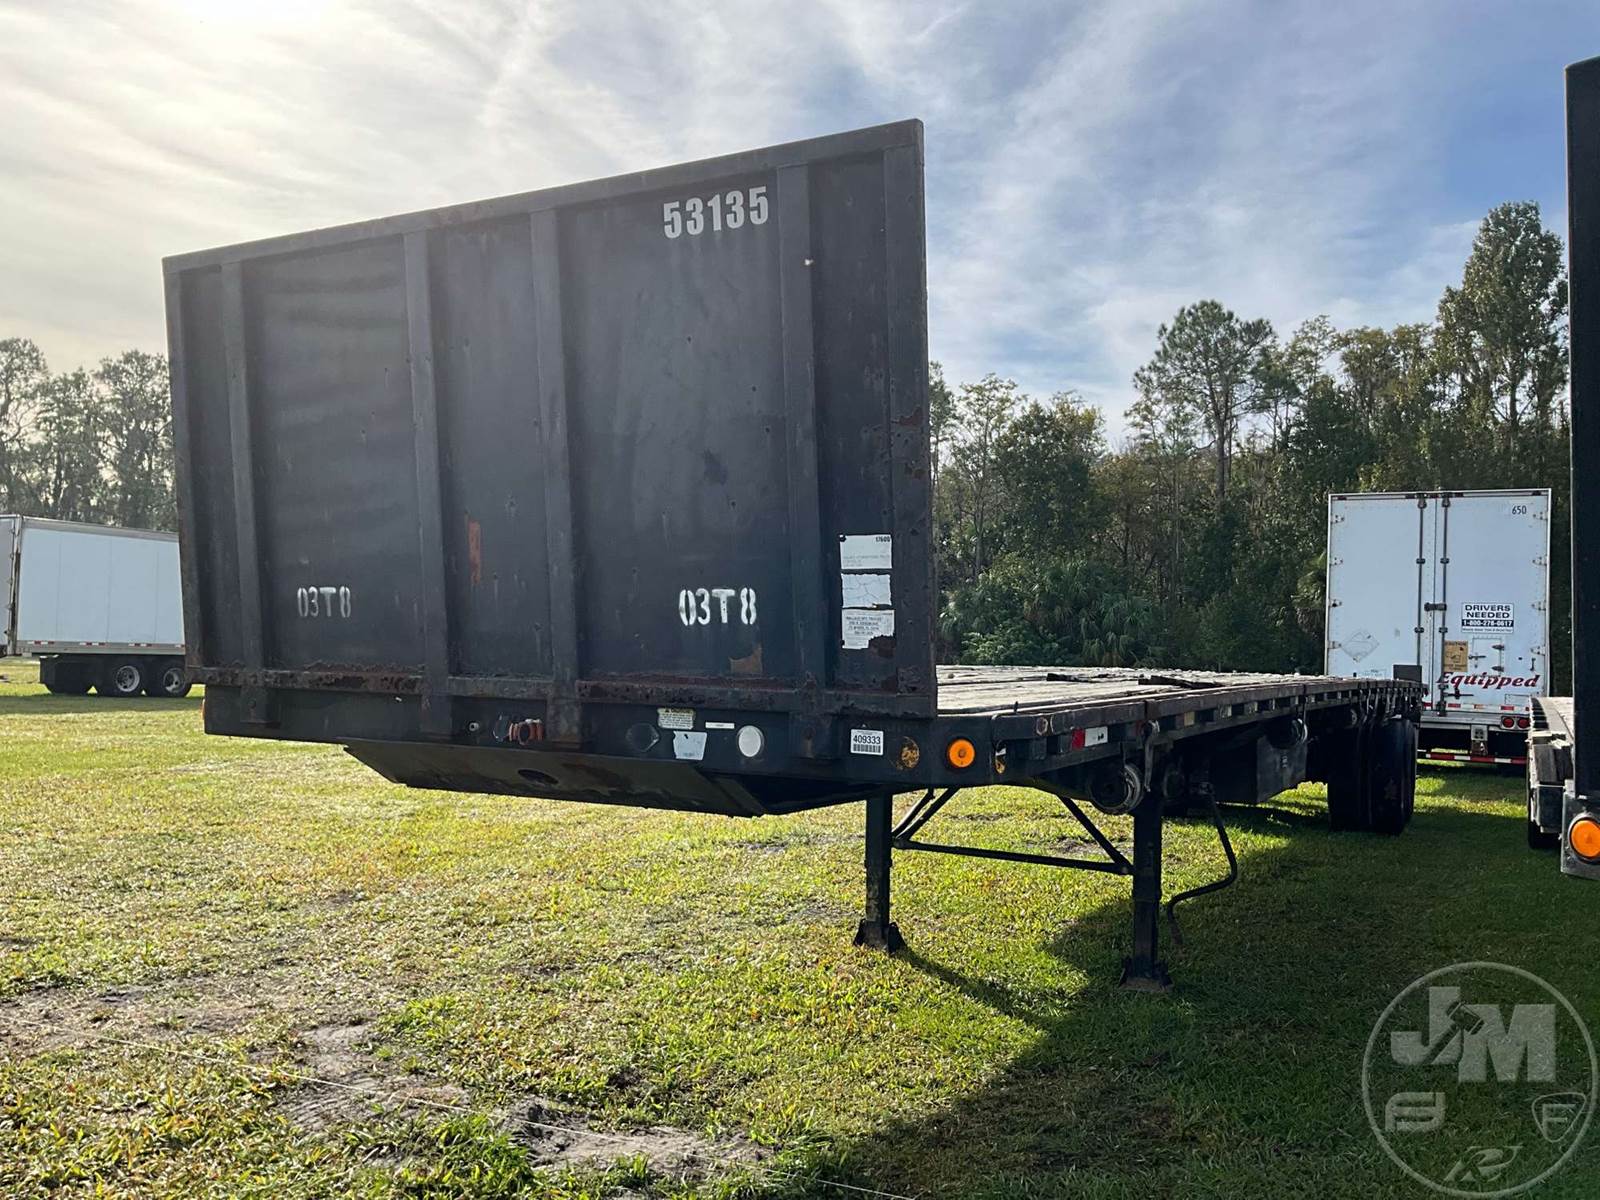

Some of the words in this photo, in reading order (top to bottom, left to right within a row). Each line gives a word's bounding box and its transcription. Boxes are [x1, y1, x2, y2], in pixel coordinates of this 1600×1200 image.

[663, 186, 769, 239] 53135
[1511, 505, 1527, 515] 650
[297, 586, 351, 618] 03T8
[679, 587, 757, 626] 03T8
[1436, 671, 1541, 690] Equipped
[853, 734, 880, 745] 409333
